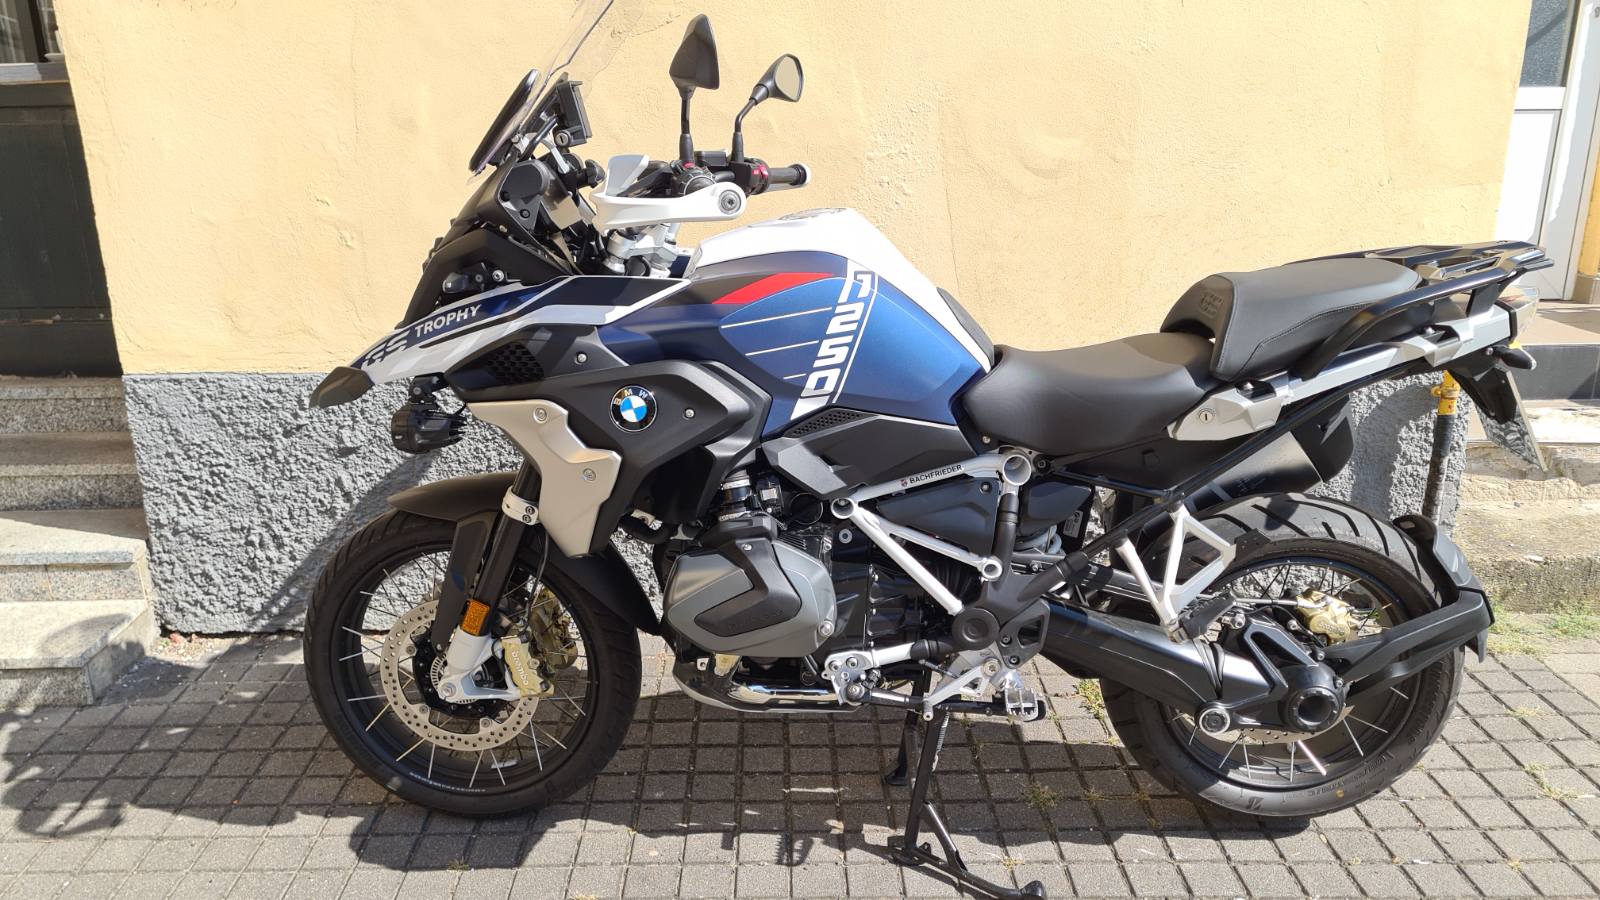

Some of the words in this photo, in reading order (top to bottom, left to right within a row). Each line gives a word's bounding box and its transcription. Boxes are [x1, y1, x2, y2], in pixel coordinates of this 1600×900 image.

[360, 328, 410, 368] GS
[414, 303, 482, 338] TROPHY
[799, 272, 874, 399] 1250
[613, 388, 649, 405] BMW
[909, 464, 963, 484] BACHFRIEDER
[511, 650, 529, 686] brembo
